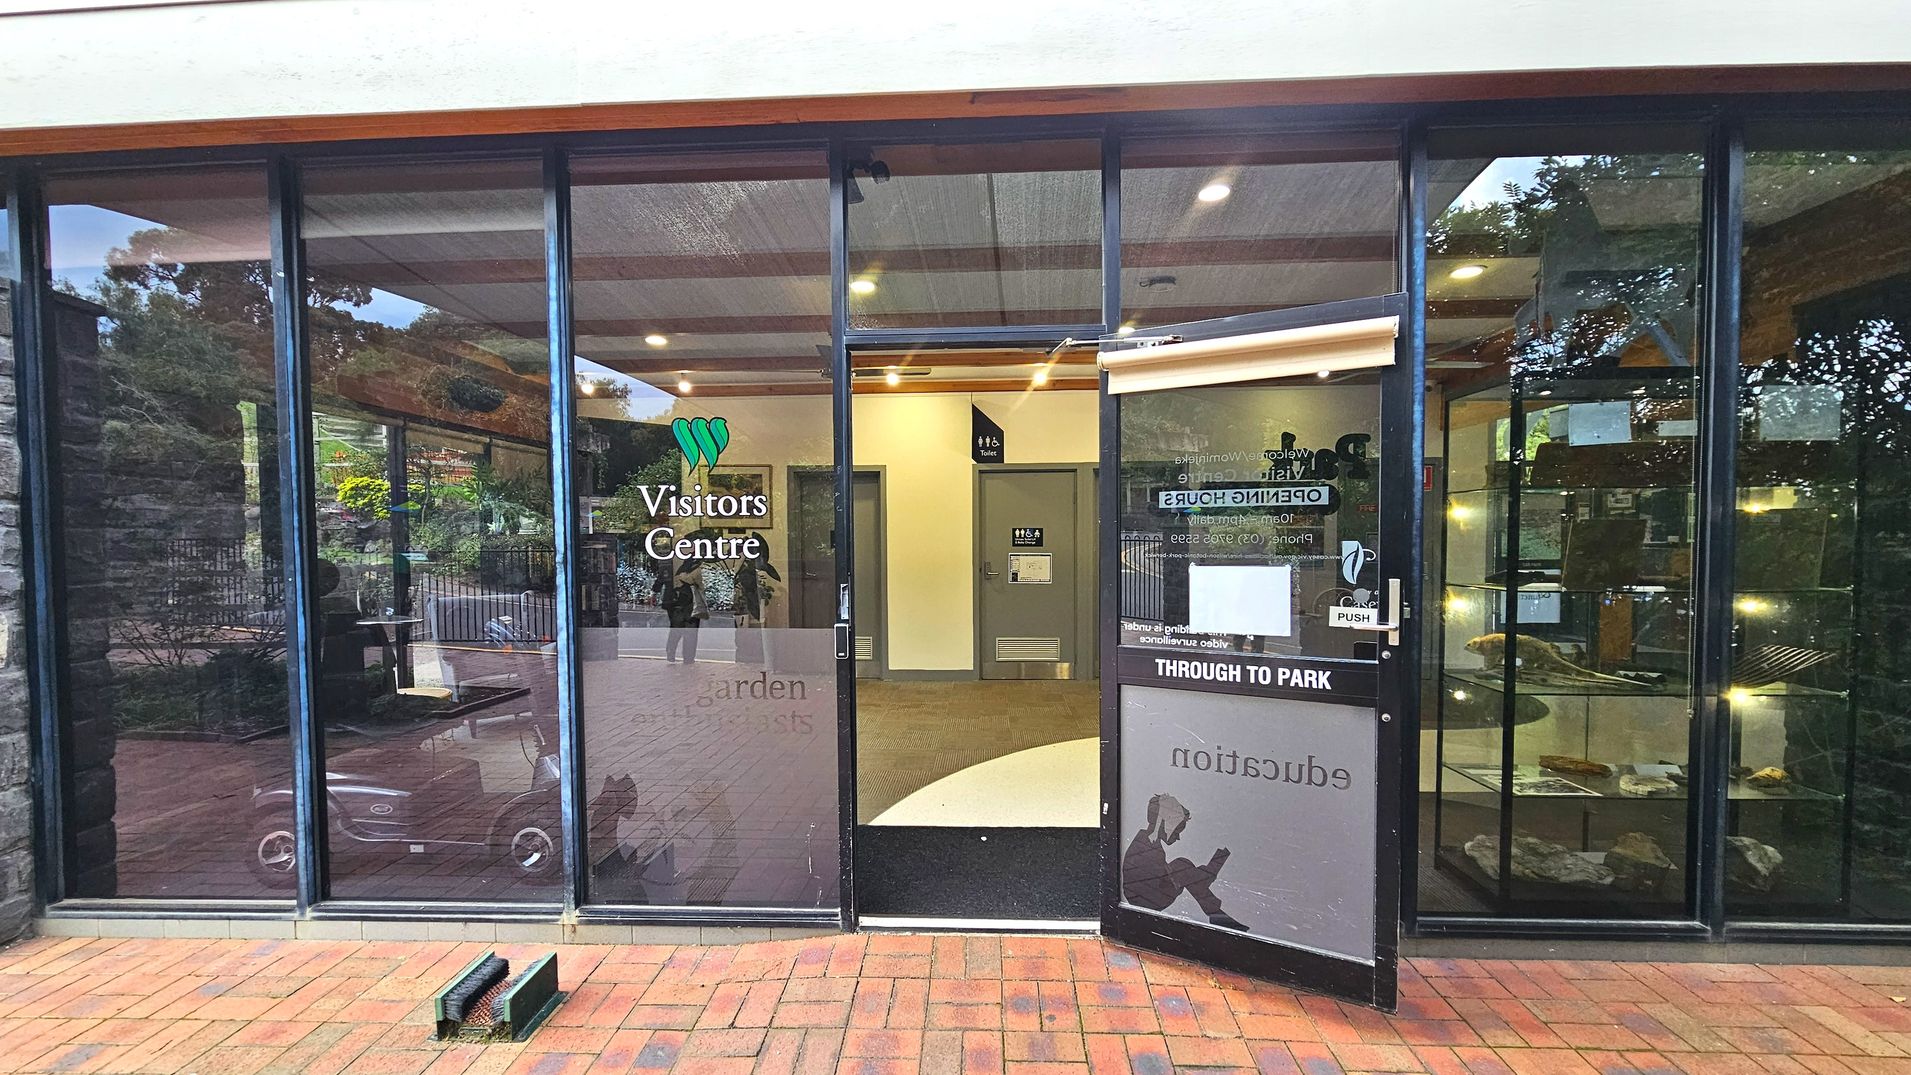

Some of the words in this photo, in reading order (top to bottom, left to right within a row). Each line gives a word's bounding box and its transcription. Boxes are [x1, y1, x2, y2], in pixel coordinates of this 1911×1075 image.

[980, 449, 997, 457] Toilet
[637, 484, 768, 518] Visitors
[644, 527, 761, 561] Centre
[1337, 612, 1370, 623] PUSH
[696, 672, 807, 707] garden
[1155, 659, 1241, 683] THROUGH
[1246, 666, 1271, 685] TO
[1277, 668, 1332, 690] PARK
